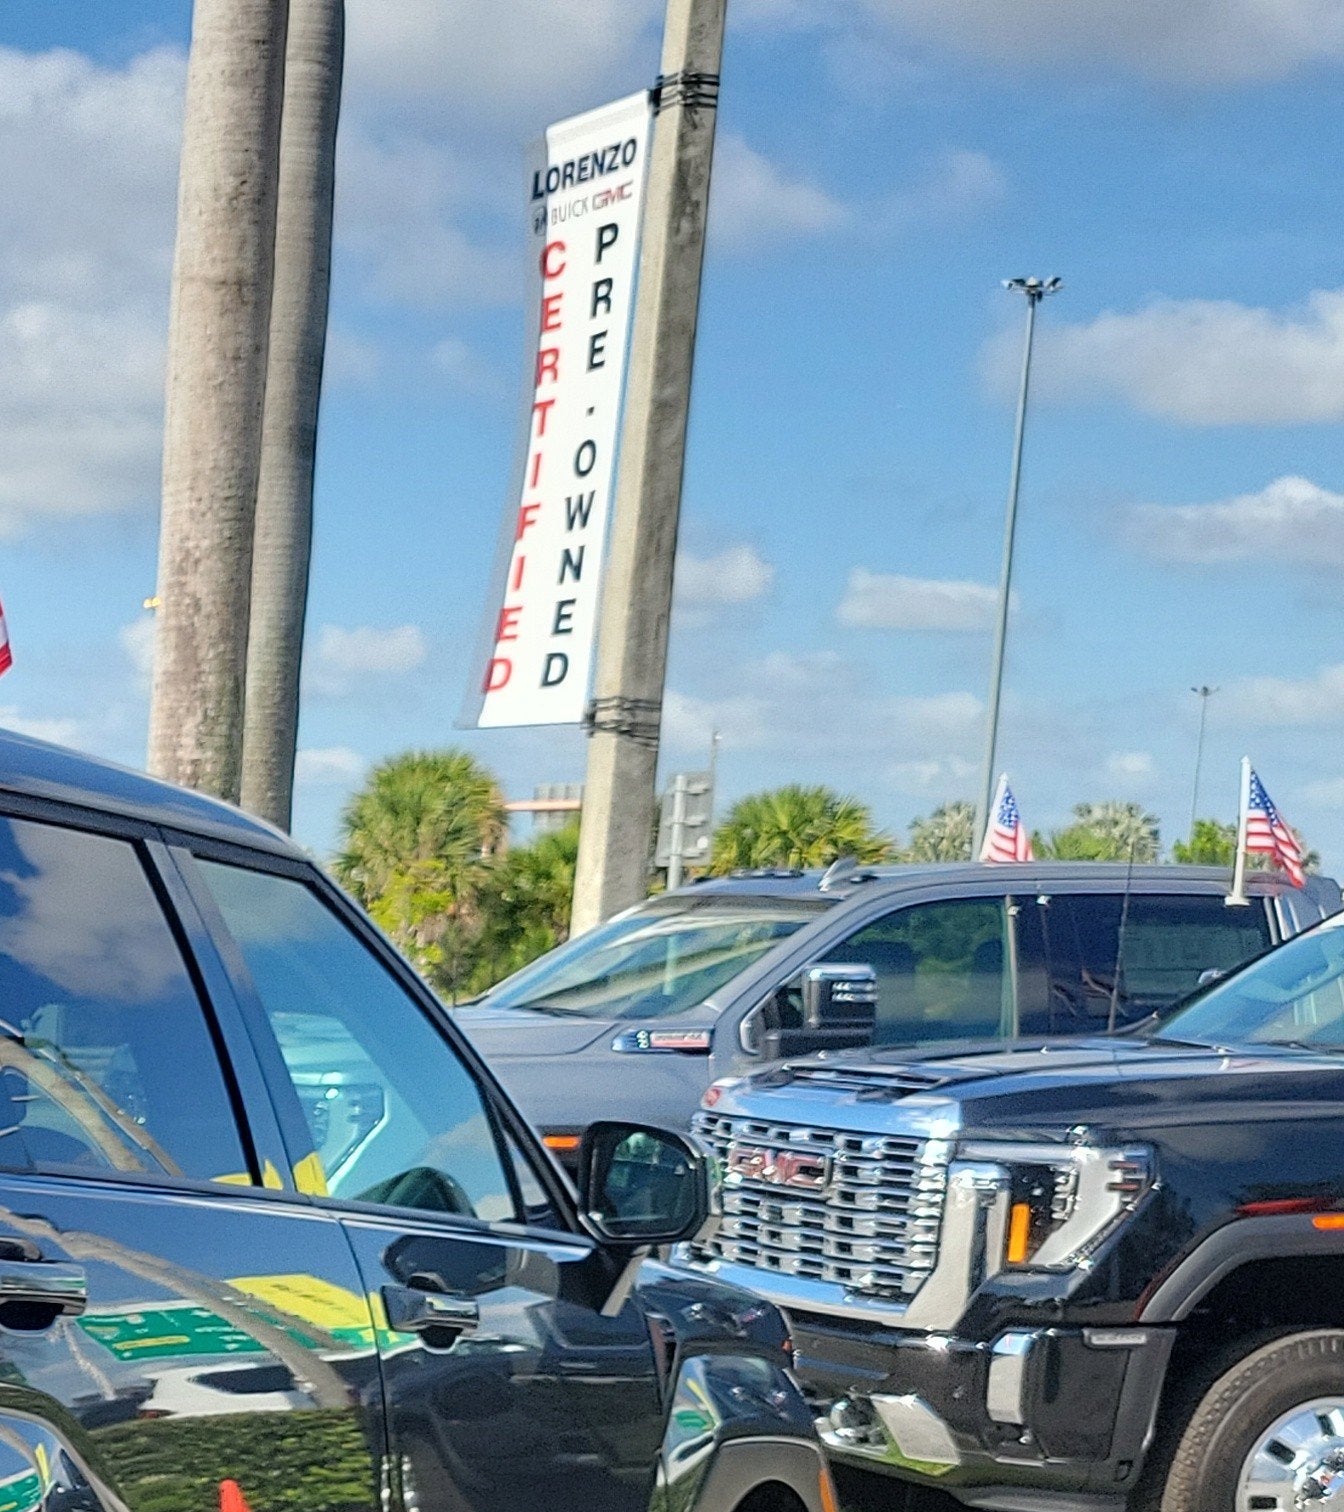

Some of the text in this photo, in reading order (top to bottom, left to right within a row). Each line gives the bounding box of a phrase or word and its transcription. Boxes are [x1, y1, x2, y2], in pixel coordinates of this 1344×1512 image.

[531, 138, 637, 202] LORENZO
[552, 181, 633, 226] BUICK GMC
[483, 241, 566, 694] CERTIFIED
